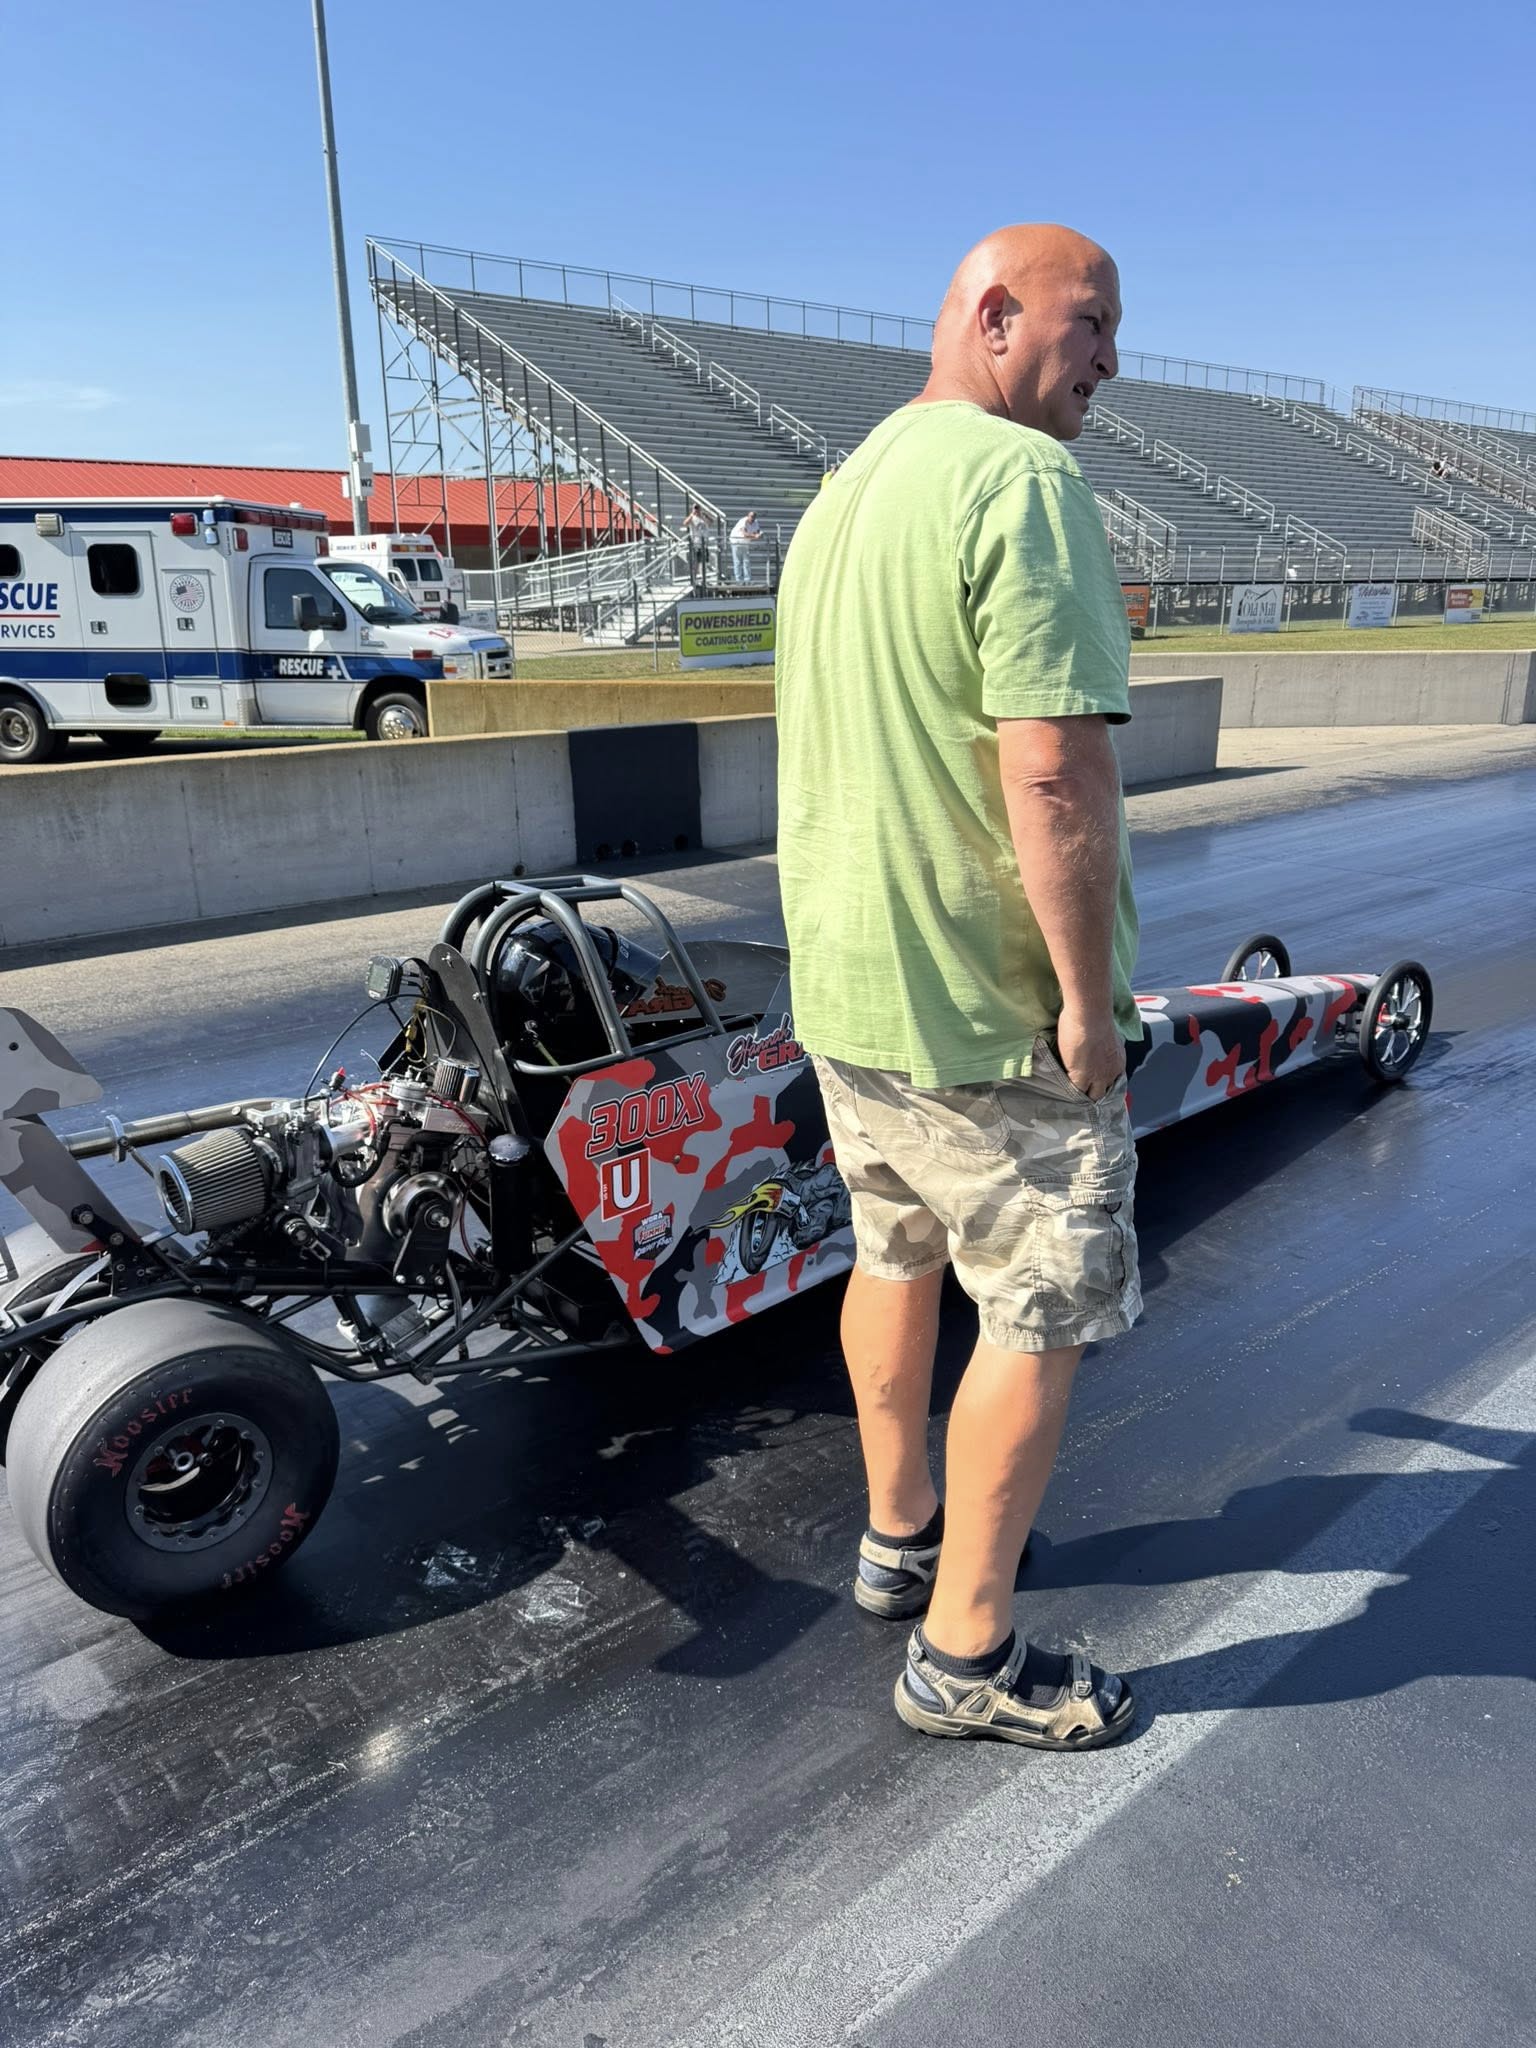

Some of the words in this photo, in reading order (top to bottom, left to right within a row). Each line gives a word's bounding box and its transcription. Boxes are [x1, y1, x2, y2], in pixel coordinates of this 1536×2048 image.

[0, 582, 58, 610] SCUE
[684, 613, 772, 631] POWERSHIELD
[695, 633, 762, 647] COATINGS.COM
[278, 658, 325, 677] RESCUE
[585, 1070, 706, 1160] 300X
[611, 1158, 641, 1210] U
